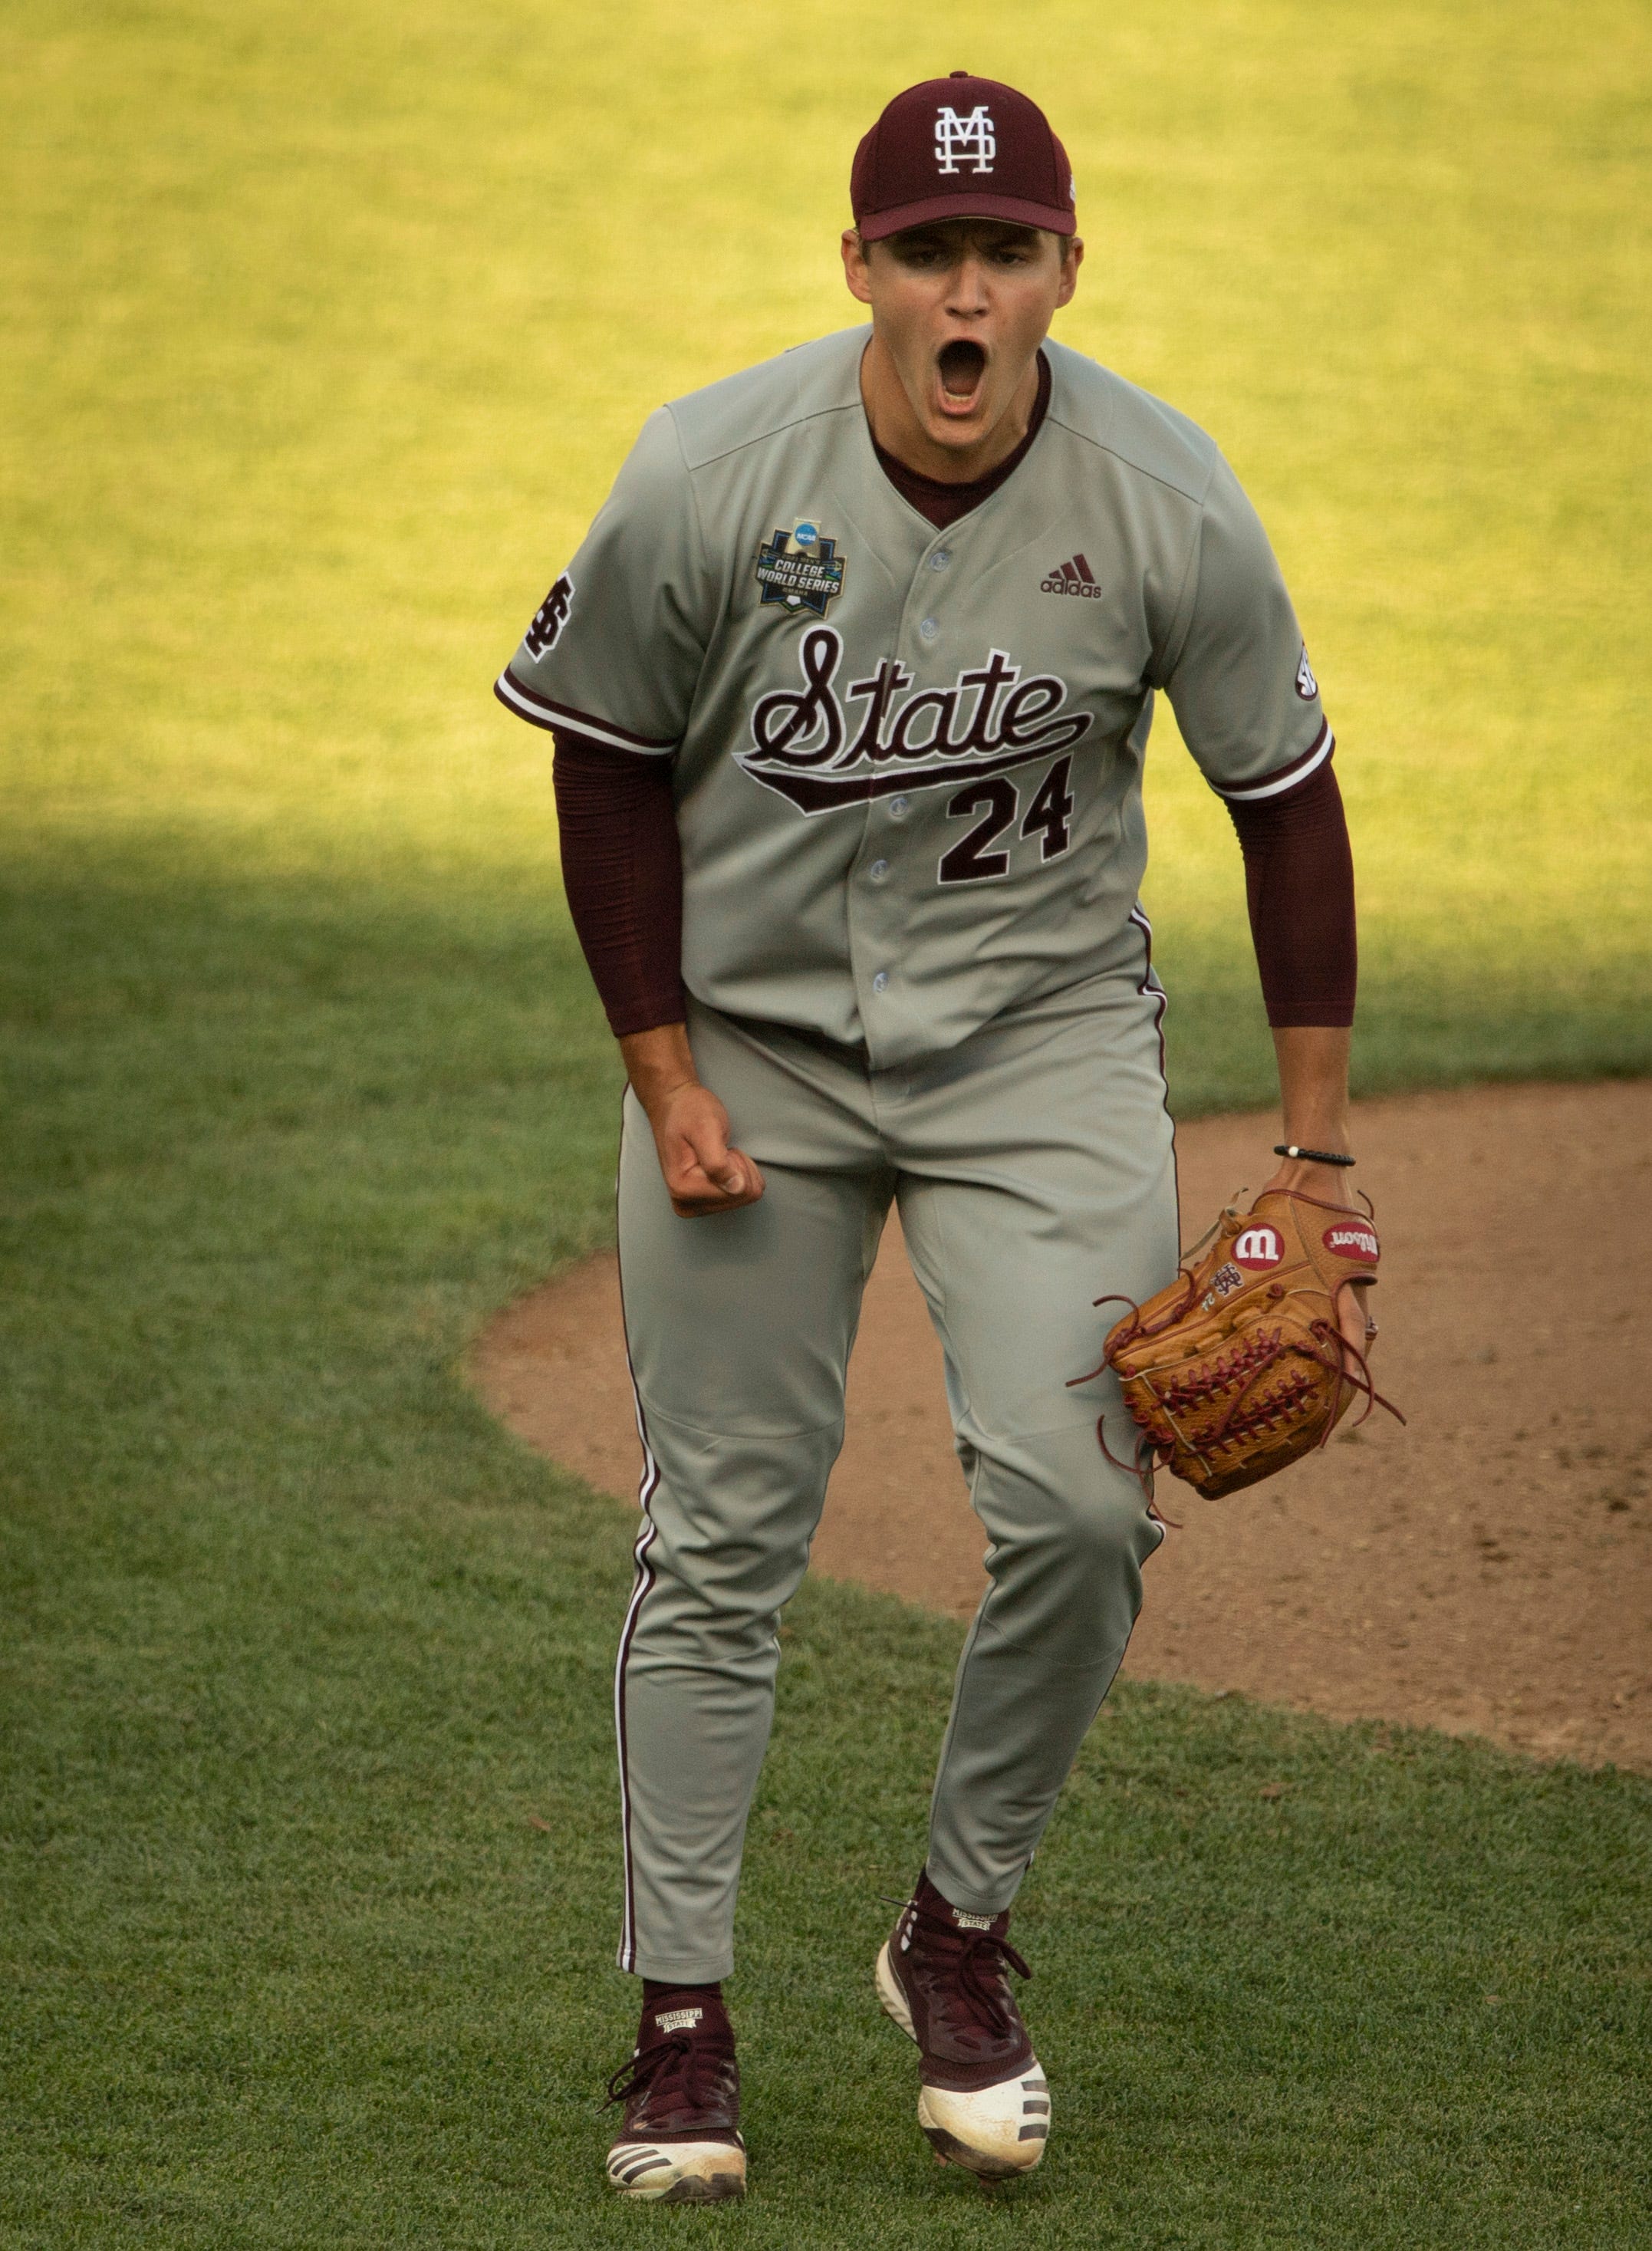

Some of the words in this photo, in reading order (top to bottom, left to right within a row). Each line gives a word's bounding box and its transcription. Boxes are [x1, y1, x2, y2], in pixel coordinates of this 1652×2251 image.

[775, 559, 825, 578] COLLEGE
[757, 567, 797, 587] WORLD
[798, 577, 839, 594] SERIES
[1041, 578, 1101, 598] adidas
[732, 625, 1094, 776] State
[937, 755, 1074, 885] 24
[963, 1920, 987, 1930] STATE
[656, 2009, 703, 2026] MISSISSIPPI
